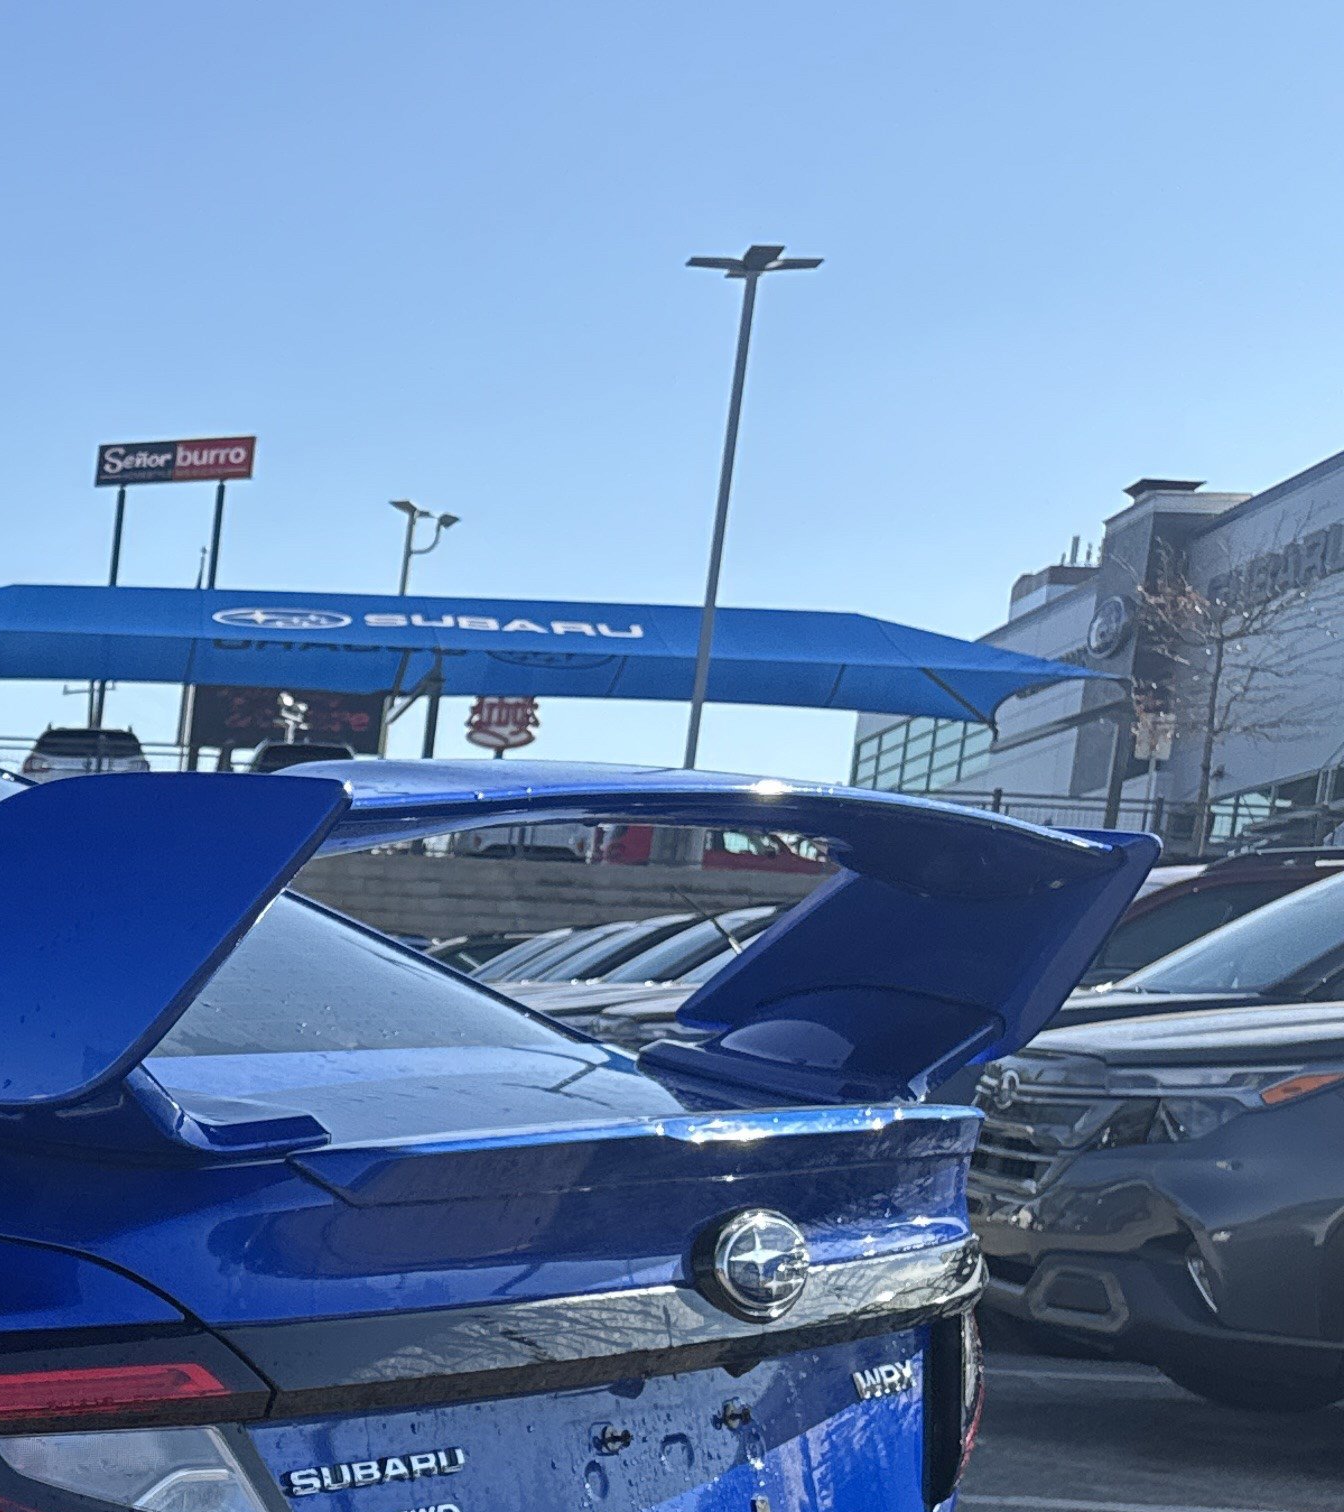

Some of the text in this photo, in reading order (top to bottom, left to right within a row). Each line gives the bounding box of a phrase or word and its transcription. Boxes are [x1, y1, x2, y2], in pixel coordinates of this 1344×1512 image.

[103, 444, 247, 474] Señor burro
[364, 613, 645, 639] SUBARU
[853, 1360, 917, 1399] WRX
[290, 1448, 465, 1495] SUBARU
